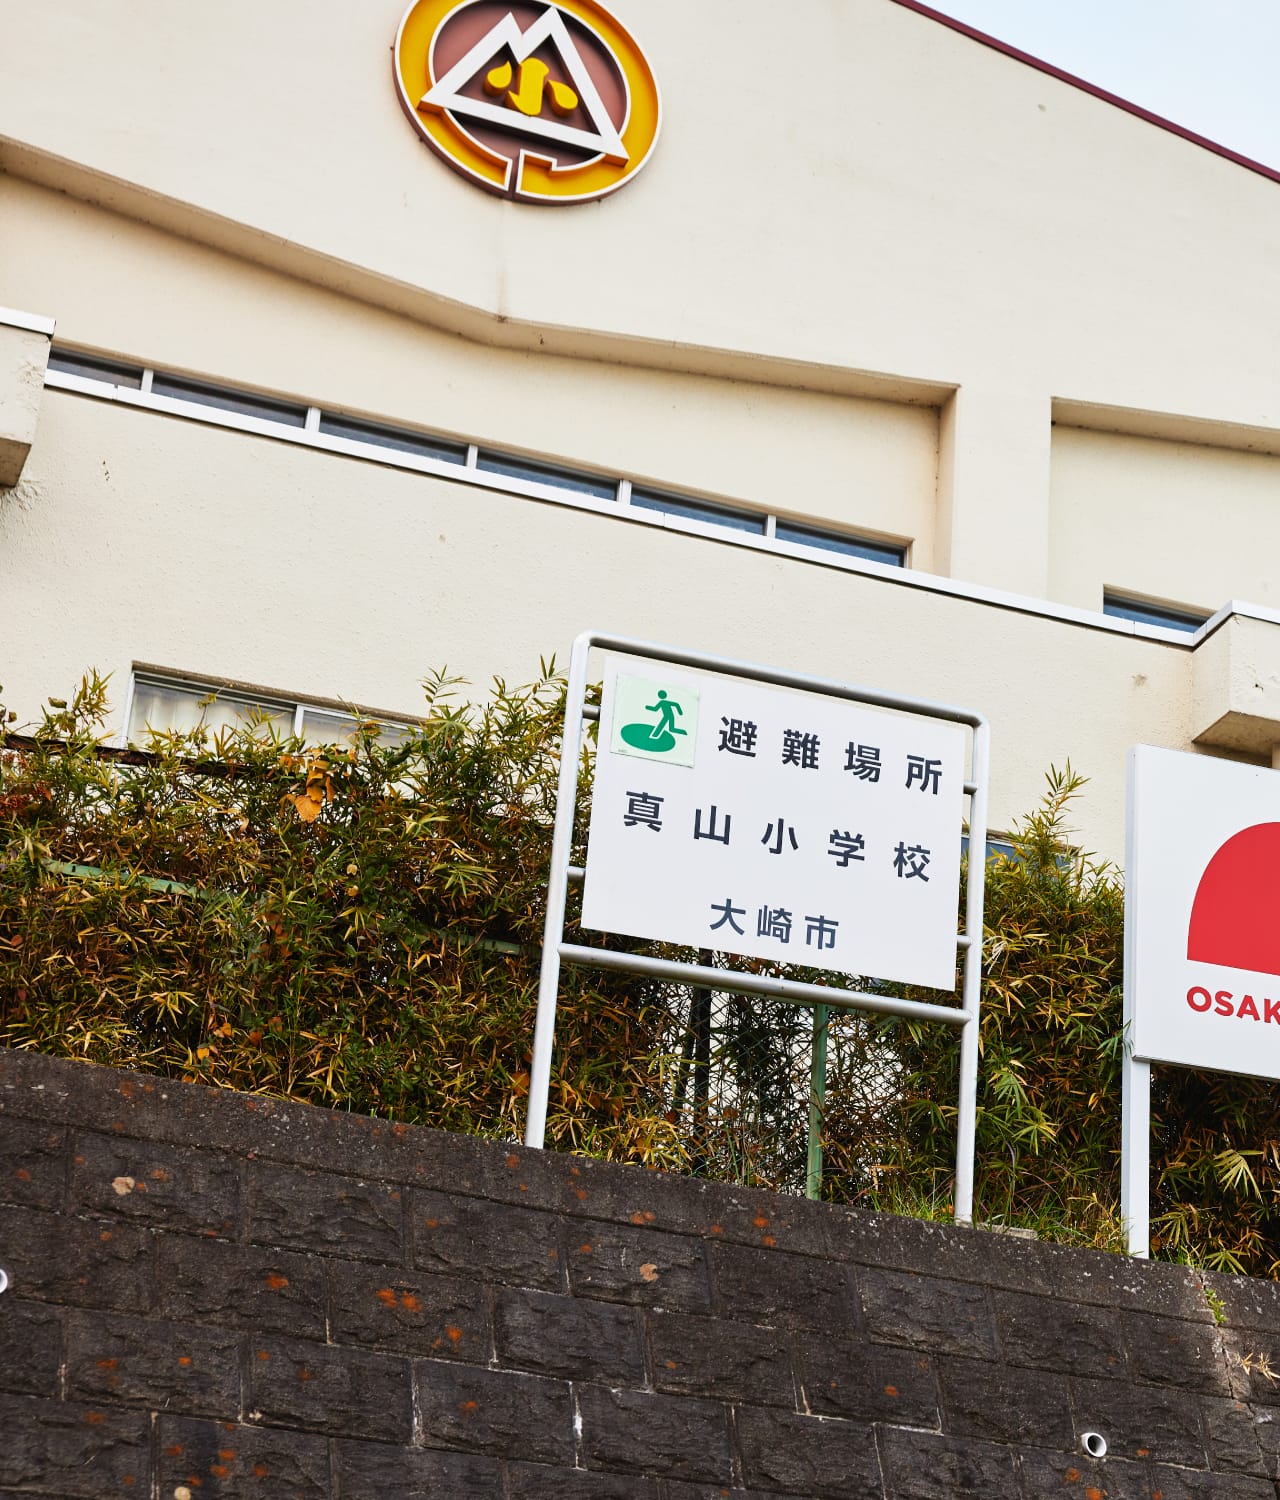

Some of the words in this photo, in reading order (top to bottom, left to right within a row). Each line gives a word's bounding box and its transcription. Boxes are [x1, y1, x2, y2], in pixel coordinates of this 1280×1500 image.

[717, 716, 943, 796] 避難場所
[623, 791, 931, 883] 真山小学校
[709, 898, 839, 950] 大崎市
